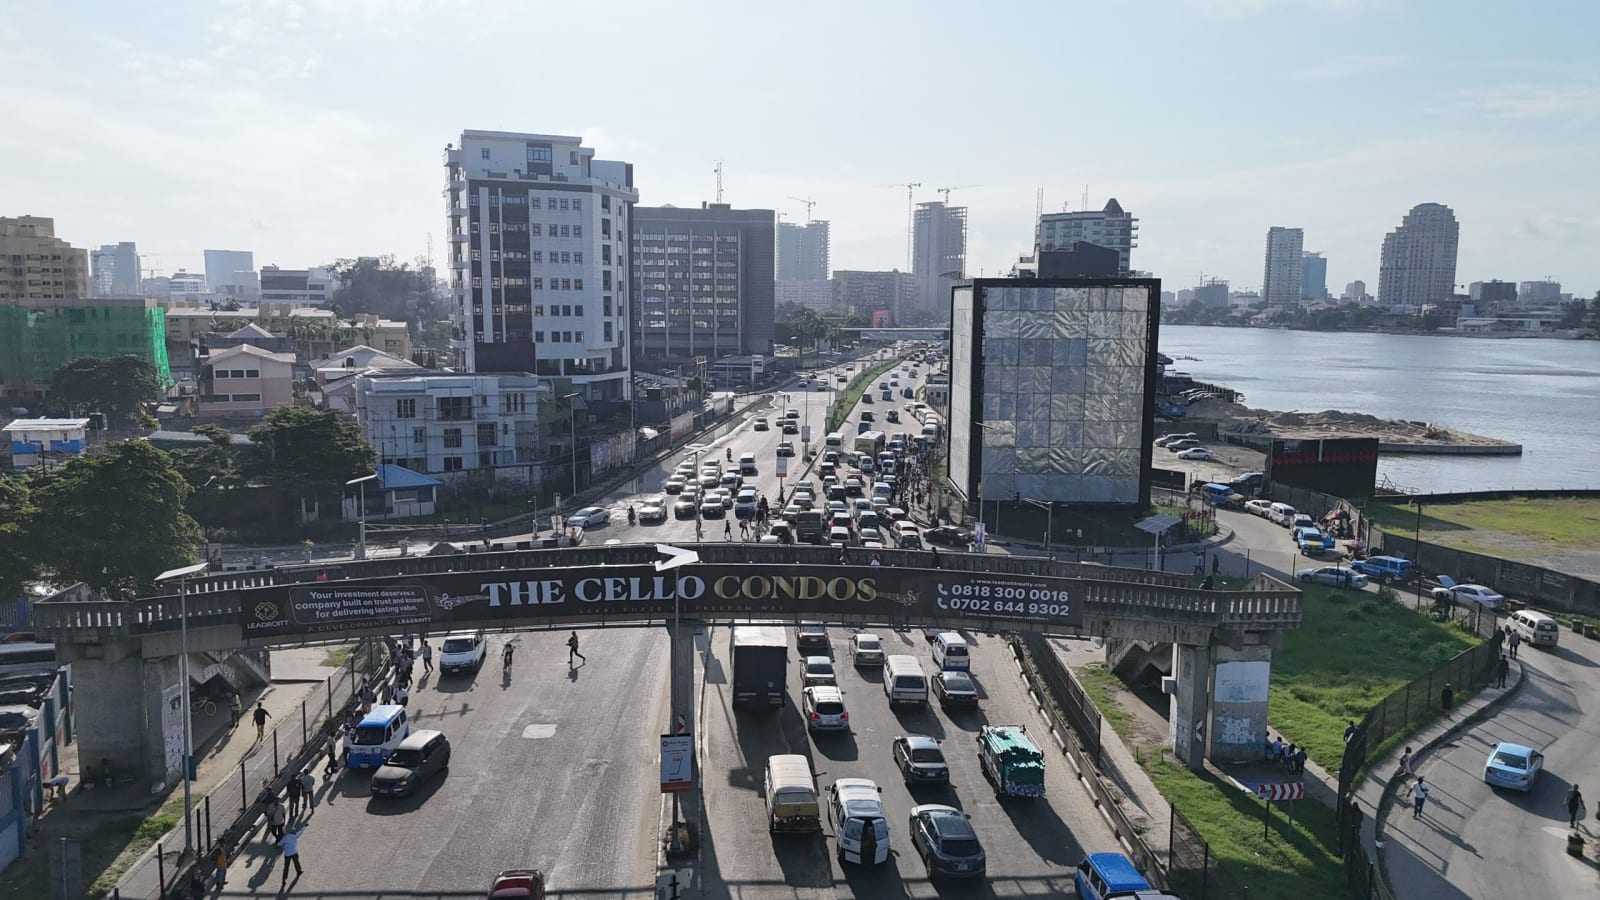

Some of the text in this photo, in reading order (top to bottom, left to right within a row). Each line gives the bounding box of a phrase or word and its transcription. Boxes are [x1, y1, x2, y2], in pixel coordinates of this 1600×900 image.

[310, 591, 333, 600] Your
[334, 590, 380, 599] investment
[480, 575, 878, 607] THE CELLO CONDOS
[951, 584, 1069, 602] 0818 300 0016
[295, 600, 341, 611] company
[342, 598, 363, 607] built
[315, 610, 330, 619] for
[331, 606, 375, 619] delivering
[375, 604, 399, 614] lasting
[950, 598, 991, 611] 0702
[993, 600, 1025, 613] 644
[1028, 602, 1069, 616] 9302
